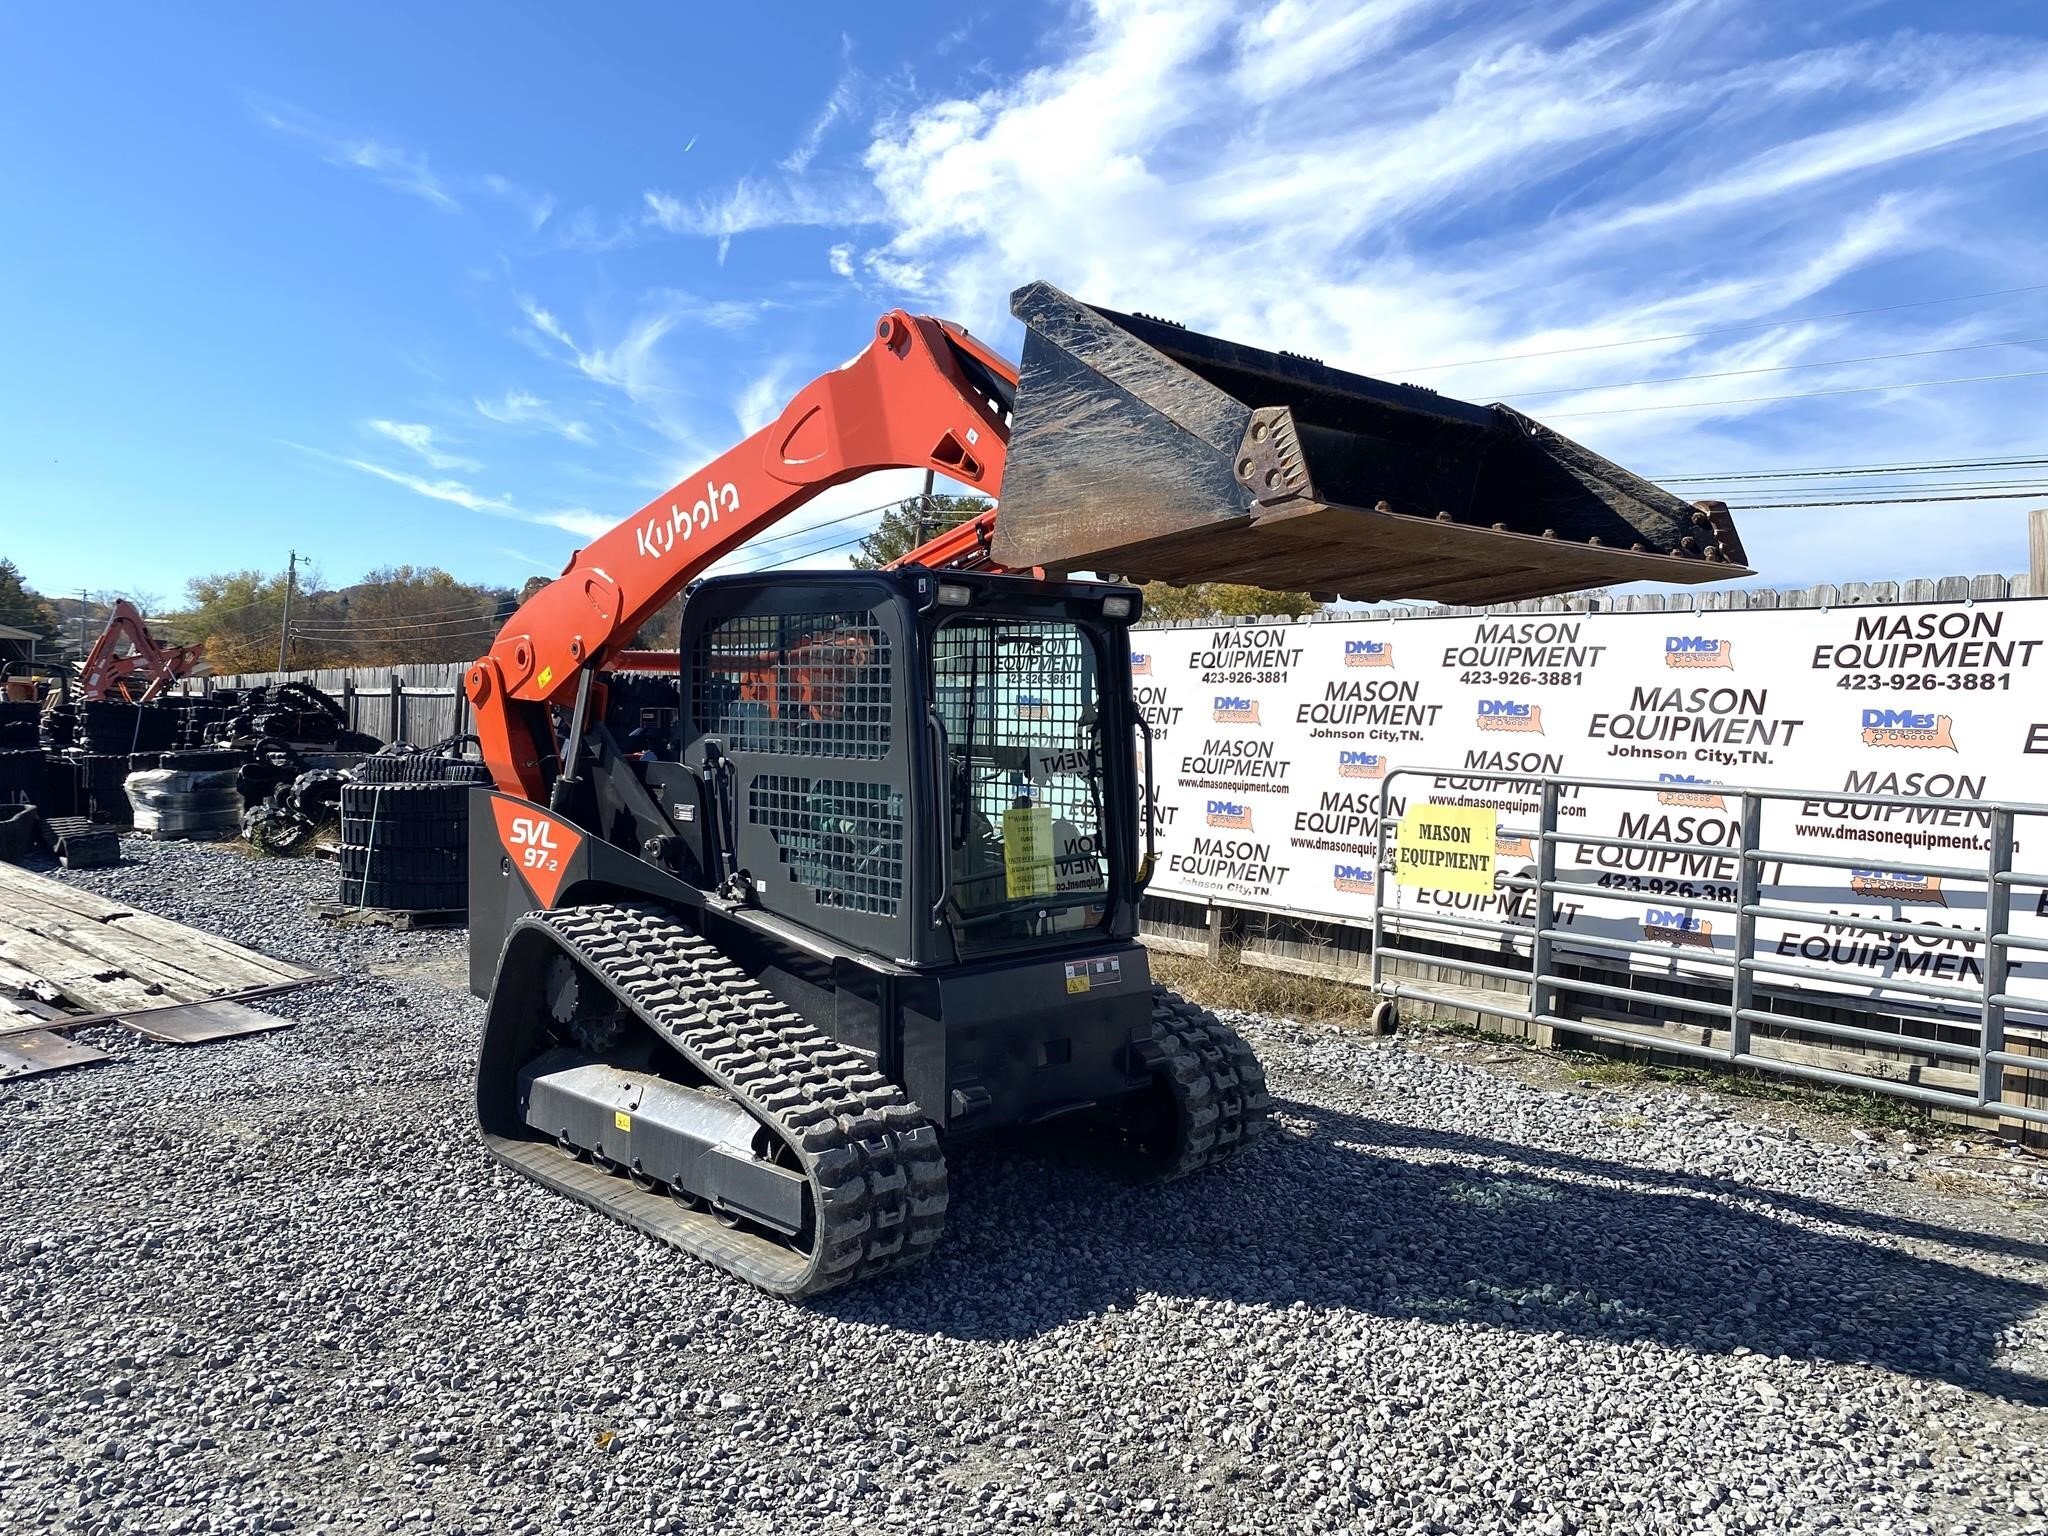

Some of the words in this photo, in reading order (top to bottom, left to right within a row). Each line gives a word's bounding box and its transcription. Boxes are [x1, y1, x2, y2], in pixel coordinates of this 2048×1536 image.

[636, 481, 740, 559] Kubota
[1475, 623, 1581, 644] MASON
[1855, 612, 2003, 640] MASON
[1212, 630, 1285, 649] MASON
[1189, 649, 1303, 668] EQUIPMENT
[1442, 647, 1606, 668] EQUIPMENT
[1811, 641, 2042, 668] EQUIPMENT
[1202, 672, 1288, 684] 423-926-3881
[1460, 672, 1582, 686] 423-926-3881
[1837, 673, 2011, 690] 423-926-3881
[1132, 688, 1167, 704] SON
[1324, 680, 1419, 702] MASON
[1630, 686, 1767, 715] MASON
[1296, 704, 1442, 726] EQUIPMENT
[1310, 728, 1364, 739] Johnson
[1588, 714, 1803, 746] EQUIPMENT
[1203, 739, 1273, 758] MASON
[1607, 745, 1687, 760] Johnson
[1182, 758, 1290, 778] EQUIPMENT
[1464, 750, 1563, 774] MASON
[1178, 778, 1289, 794] www.dmasonequipment.com
[1843, 770, 1986, 800] MASON
[1429, 794, 1586, 817] www.dmasonequipm.com
[1802, 800, 1993, 829] EQUIPMEN
[510, 818, 557, 849] SVL
[1419, 824, 1471, 843] MASON
[1795, 824, 2020, 853] www.dmasonequipment.cm
[1193, 838, 1270, 862] MASON
[1400, 848, 1489, 871] EQUIPMENT
[1170, 855, 1290, 885] EQUIPMENT
[1575, 844, 1783, 885] EQUIPMET
[1179, 876, 1223, 890] Johnson
[1776, 932, 2022, 984] EQUIPMEN
